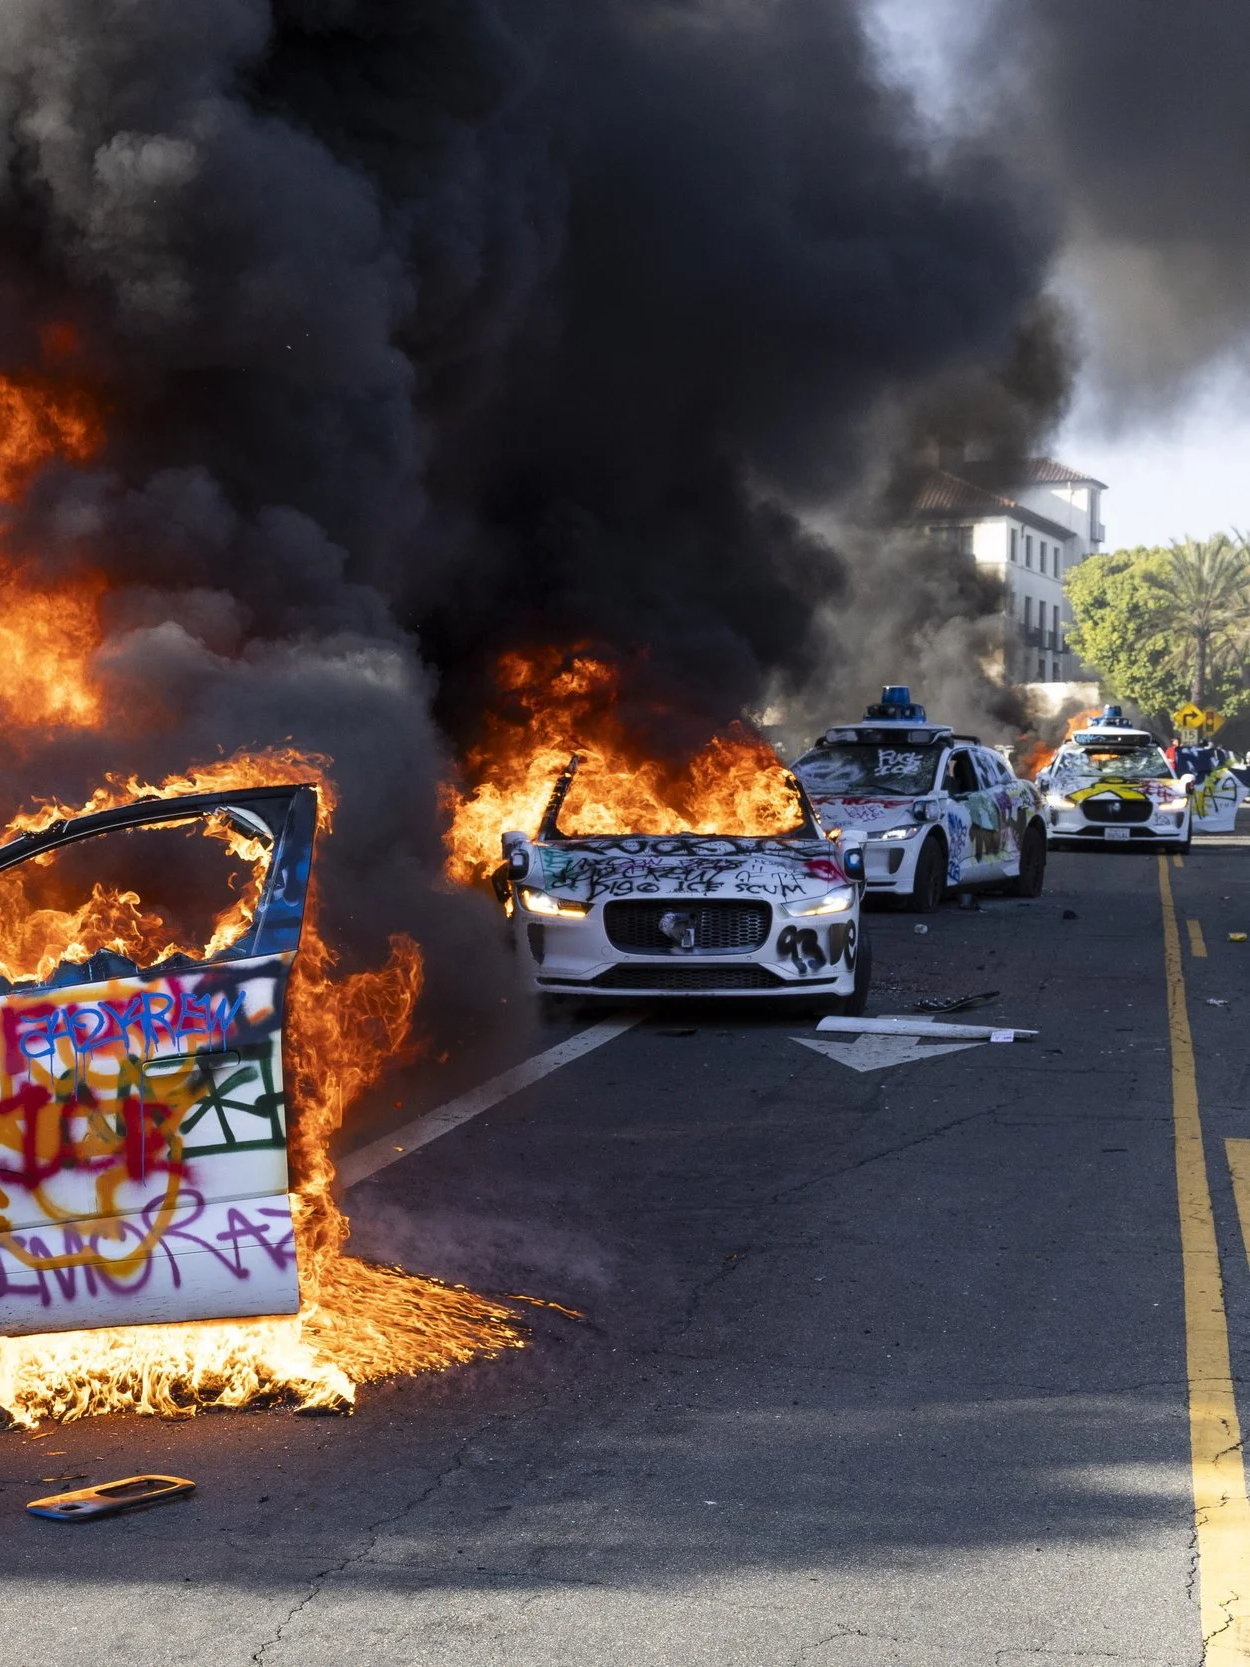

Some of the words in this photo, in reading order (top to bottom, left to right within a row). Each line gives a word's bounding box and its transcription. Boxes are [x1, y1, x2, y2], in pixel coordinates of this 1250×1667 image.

[1183, 731, 1196, 740] 15
[878, 749, 923, 768] FUCK
[676, 881, 725, 893] ICE
[735, 883, 807, 897] SCUM
